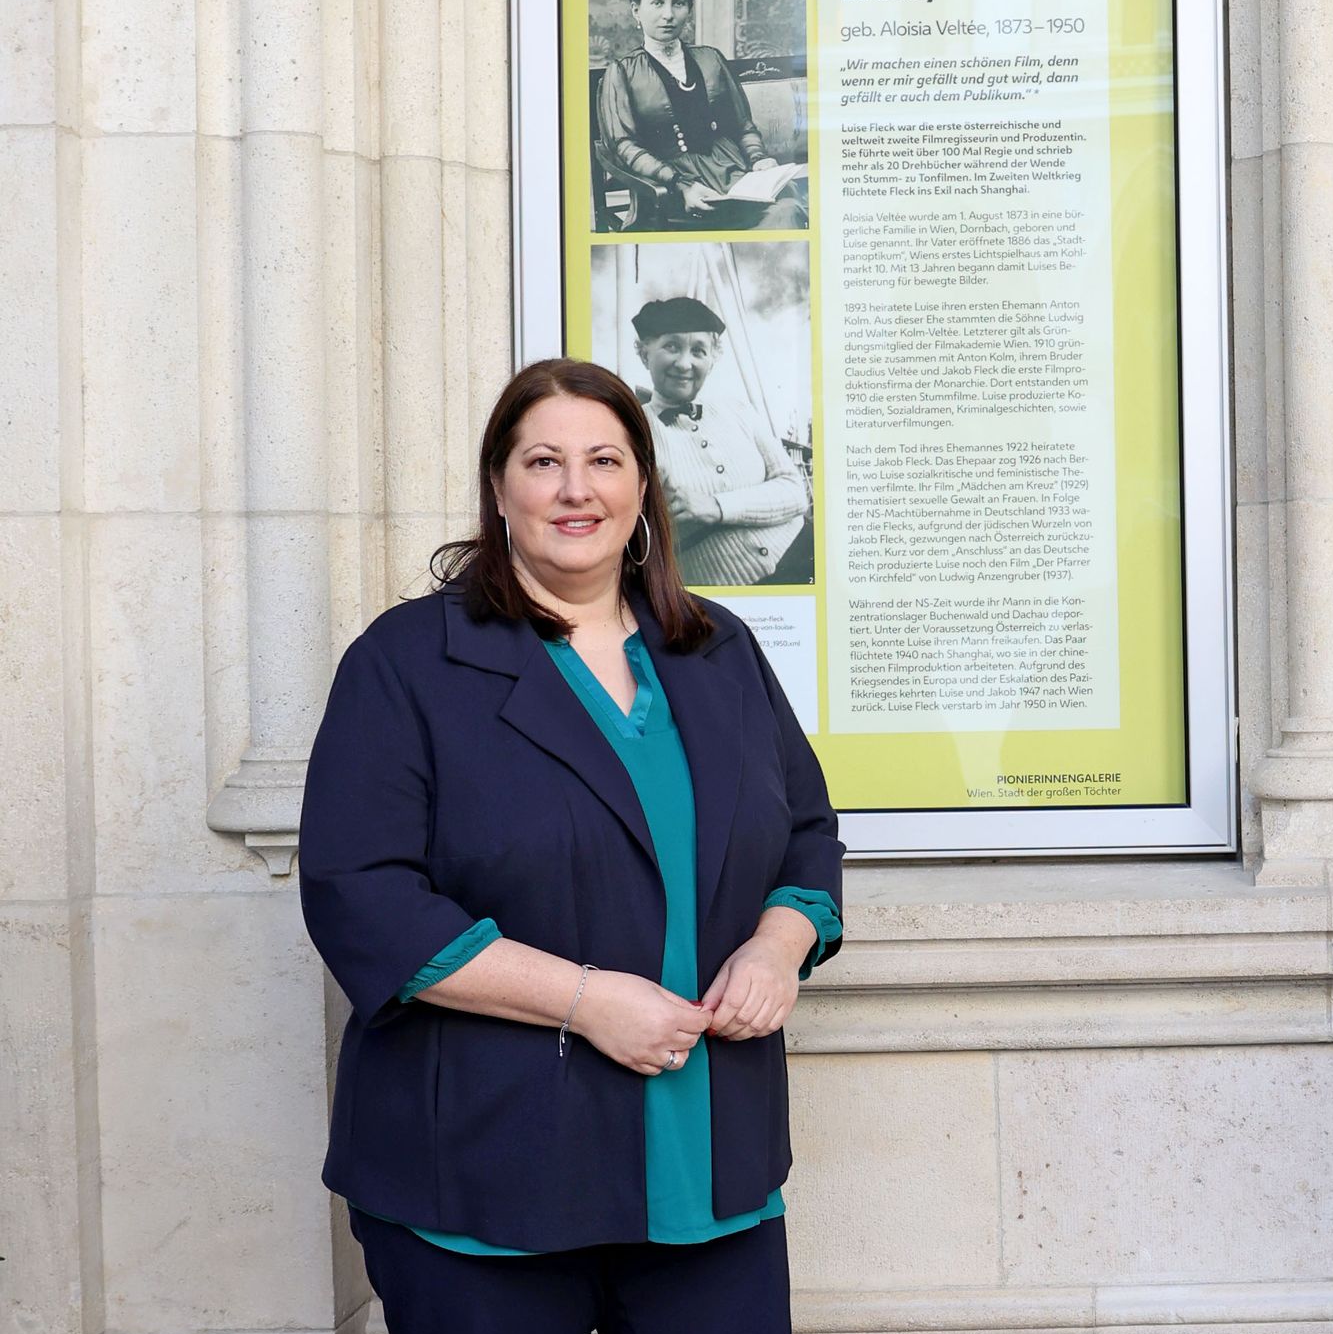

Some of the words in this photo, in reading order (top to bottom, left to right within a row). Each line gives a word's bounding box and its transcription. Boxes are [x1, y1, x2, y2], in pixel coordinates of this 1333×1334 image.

[840, 21, 876, 42] geb.
[880, 21, 931, 36] Aloisia
[936, 20, 989, 37] Veltée,
[872, 58, 920, 69] machen
[924, 58, 957, 68] einen
[960, 57, 1011, 68] schönen
[1014, 56, 1043, 68] Film,
[1048, 55, 1078, 66] denn
[878, 78, 890, 86] er
[893, 75, 914, 85] mir
[916, 73, 958, 89] gefällt
[961, 73, 985, 84] und
[987, 75, 1008, 87] gut
[1012, 72, 1042, 85] wird,
[1047, 71, 1078, 83] dann
[841, 91, 882, 106] gefällt
[900, 90, 930, 102] auch
[934, 90, 960, 101] dem
[842, 124, 867, 133] Luise
[870, 123, 895, 132] Fleck
[919, 123, 934, 131] die
[936, 123, 962, 131] erste
[964, 121, 1040, 130] österreichische
[1042, 120, 1061, 129] und
[842, 136, 884, 145] weltweit
[888, 135, 919, 144] zweite
[922, 134, 998, 145] Filmregisseurin
[1001, 133, 1020, 142] und
[1023, 133, 1086, 142] Produzentin.
[842, 149, 856, 158] Sie
[859, 149, 890, 157] führte
[892, 148, 914, 157] weit
[916, 147, 939, 157] über
[942, 147, 960, 156] 100
[963, 147, 981, 155] Mal
[984, 147, 1012, 157] Regie
[1015, 146, 1034, 155] und
[1036, 145, 1072, 155] schrieb
[842, 187, 887, 196] flüchtete
[890, 187, 915, 195] Fleck
[918, 187, 932, 195] ins
[935, 186, 951, 195] Exil
[954, 185, 978, 194] nach
[981, 185, 1029, 195] Shanghai.
[842, 213, 874, 222] Aloisia
[876, 213, 906, 222] Veltée
[909, 212, 940, 221] wurde
[969, 211, 1003, 222] August
[1006, 210, 1028, 219] 1873
[1031, 211, 1040, 219] in
[1042, 211, 1062, 219] eine
[1065, 210, 1084, 219] bür-
[846, 418, 954, 429] Literaturverfilmungen.
[852, 702, 885, 711] zurück.
[888, 702, 912, 711] Luise
[916, 701, 939, 710] Fleck
[942, 701, 982, 710] verstarb
[985, 701, 996, 709] im
[1000, 700, 1020, 709] Jahr
[1024, 699, 1046, 708] 1950
[1060, 699, 1086, 708] Wien.
[997, 773, 1121, 784] PIONIERINNENGALERIE
[967, 789, 995, 797] Wien.
[998, 787, 1025, 797] Stadt
[1027, 787, 1043, 797] der
[1046, 787, 1081, 799] großen
[1084, 786, 1122, 795] Töchter
